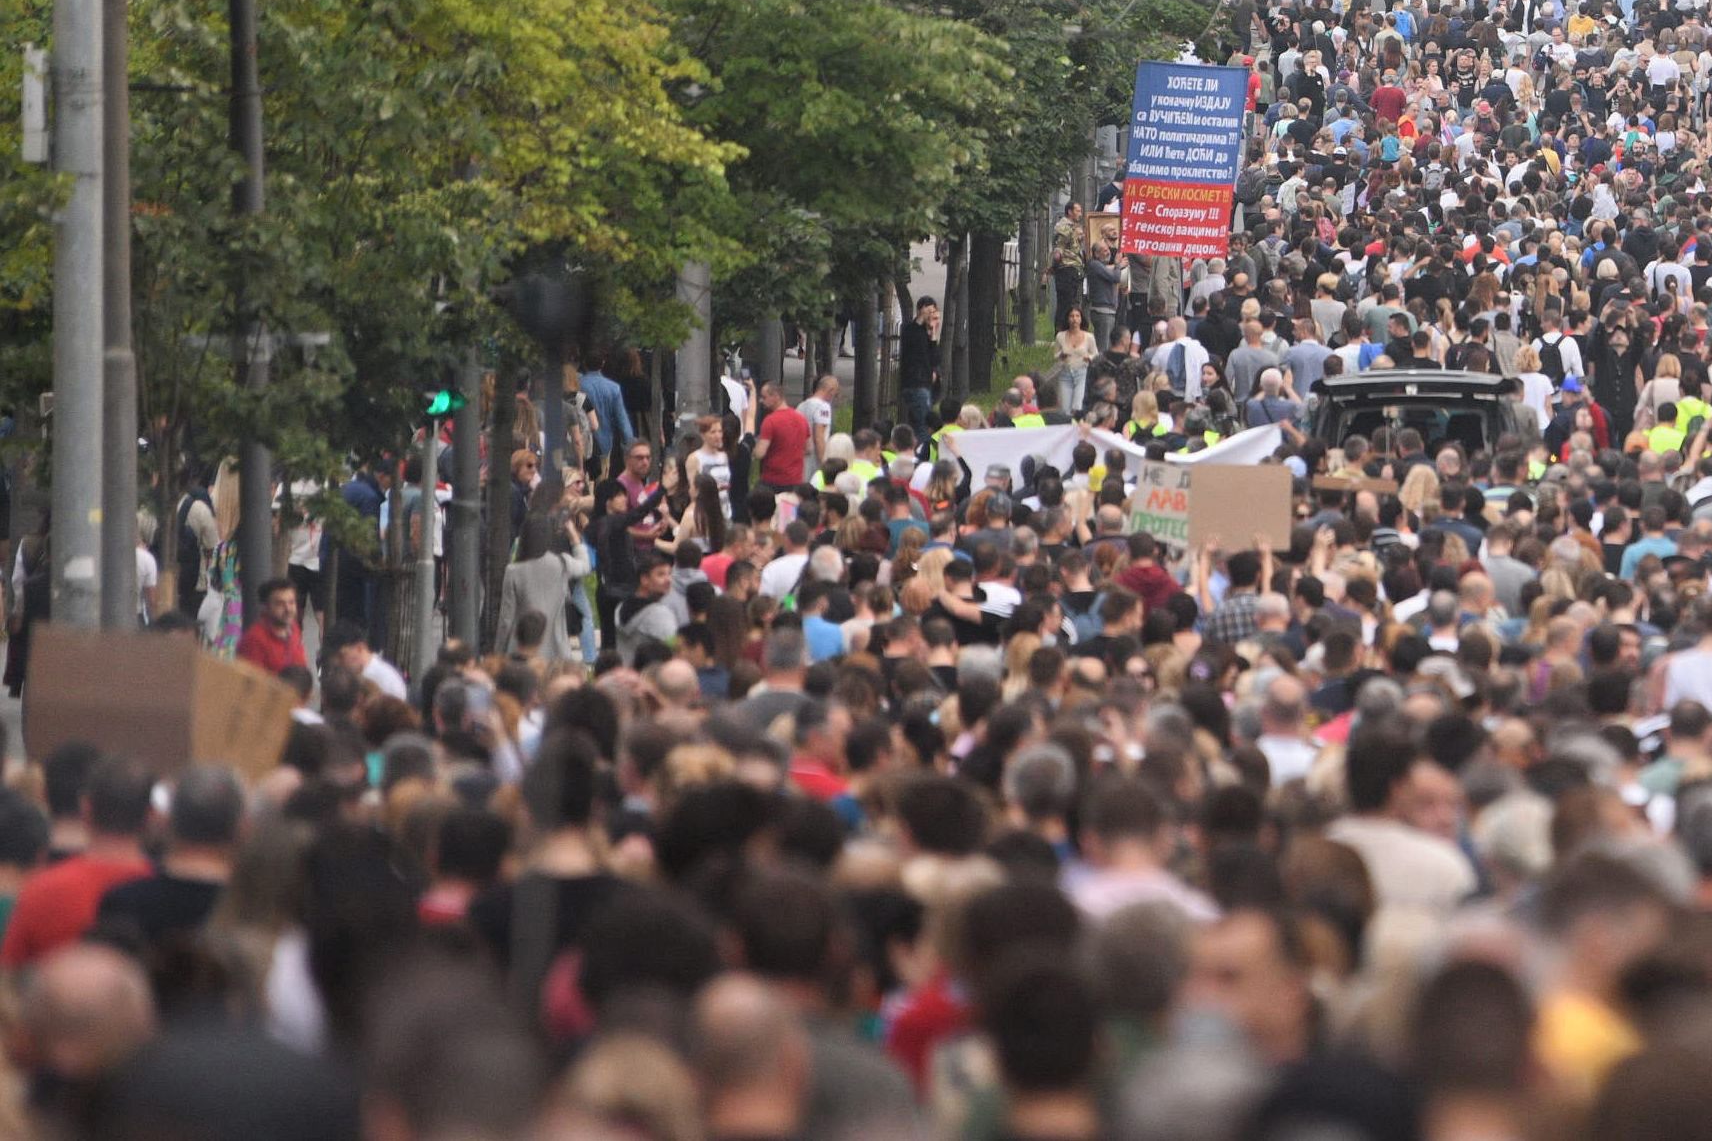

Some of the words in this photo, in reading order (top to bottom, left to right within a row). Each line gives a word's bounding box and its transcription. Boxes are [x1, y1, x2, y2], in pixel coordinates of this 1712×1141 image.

[1204, 78, 1219, 92] ЛИ
[1137, 111, 1147, 121] са
[1133, 126, 1157, 139] НАТО
[1140, 144, 1163, 158] ИЛИ
[1215, 152, 1228, 164] да
[1140, 185, 1180, 200] СРБСКИ
[1181, 189, 1221, 202] КОСМЕТ
[1130, 201, 1146, 215] НЕ
[1155, 205, 1207, 221] Споразуму
[1135, 222, 1176, 237] генској
